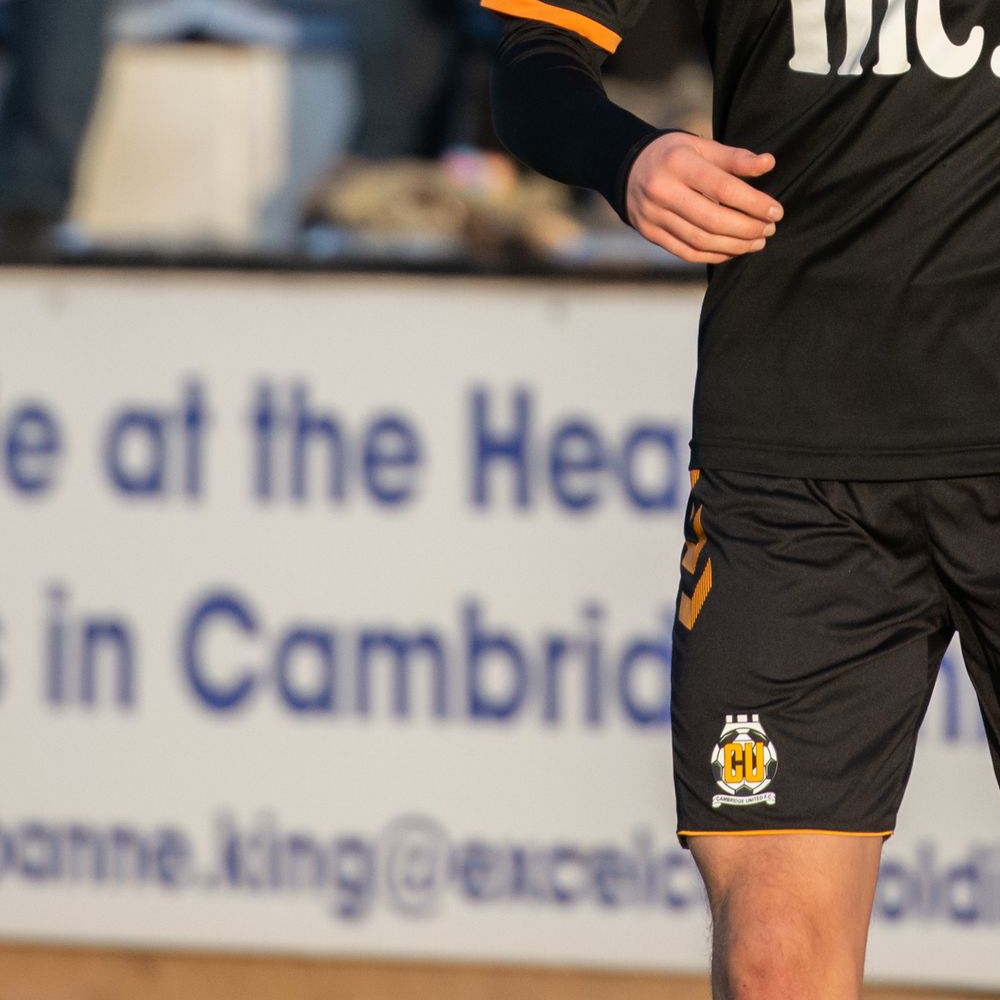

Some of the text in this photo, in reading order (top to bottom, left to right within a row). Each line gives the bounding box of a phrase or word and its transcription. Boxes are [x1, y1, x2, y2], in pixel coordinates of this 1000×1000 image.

[0, 378, 686, 512] e at the Hea
[45, 585, 136, 706] in
[724, 741, 765, 783] CU
